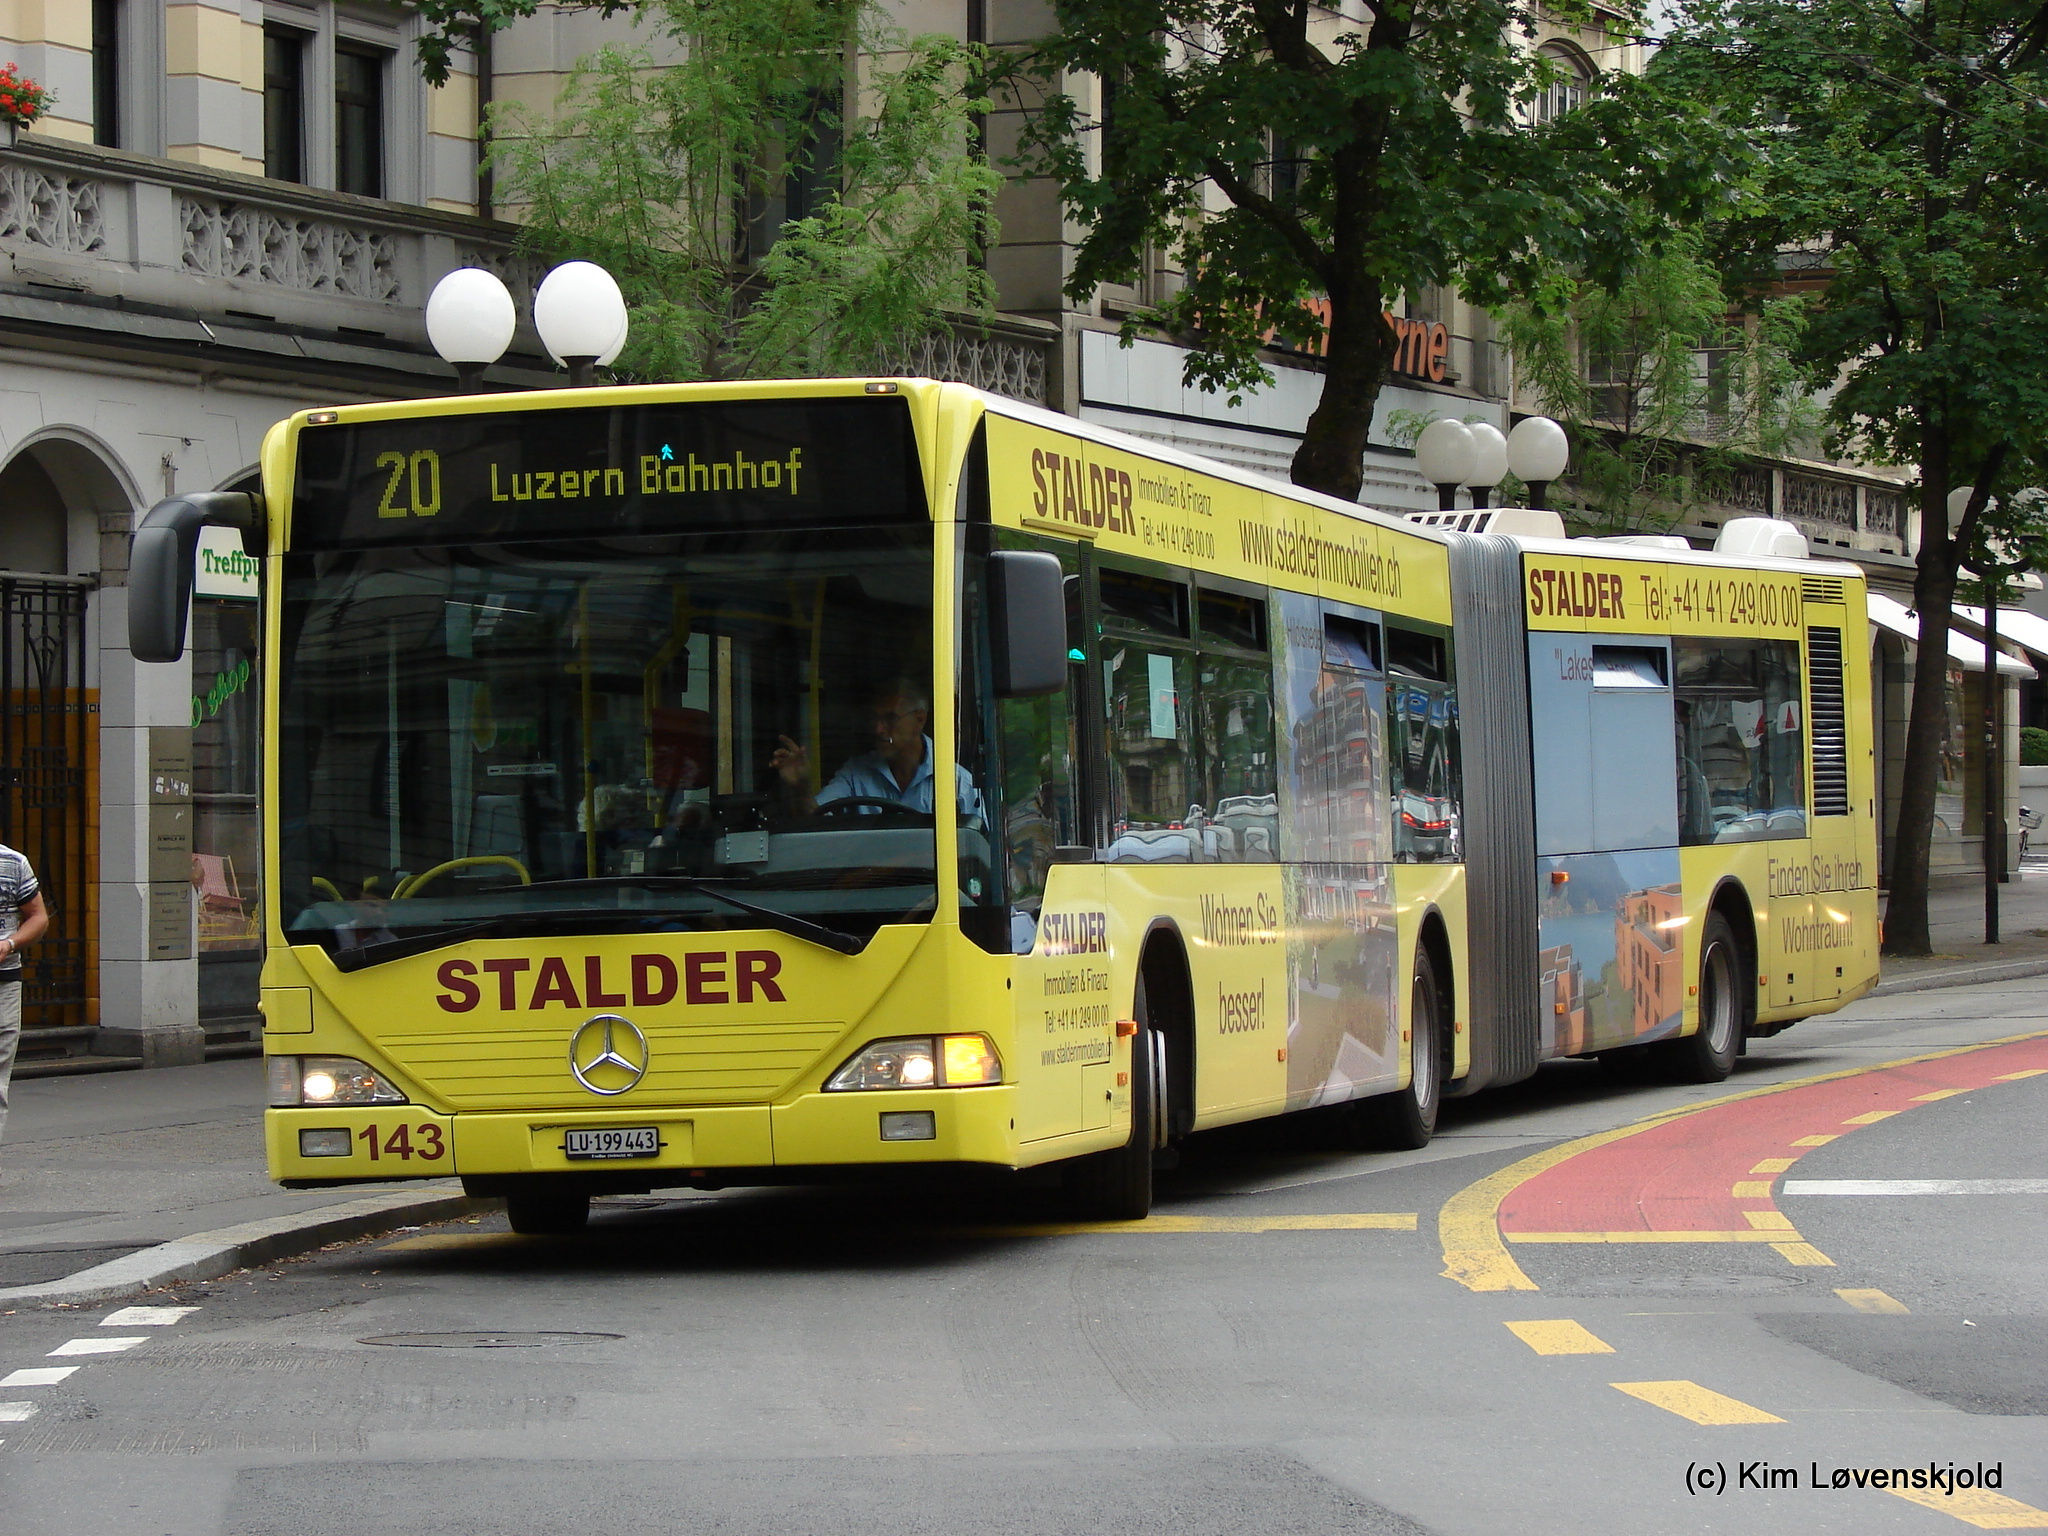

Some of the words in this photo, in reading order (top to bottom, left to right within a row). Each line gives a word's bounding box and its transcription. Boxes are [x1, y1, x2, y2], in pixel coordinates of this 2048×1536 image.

[376, 449, 441, 518] 20
[491, 463, 625, 502] Luzern
[640, 447, 802, 495] Bahnhof
[1031, 447, 1136, 537] STALDER
[1137, 470, 1180, 508] Immobilien
[1180, 481, 1187, 510] &
[1187, 483, 1213, 517] Finanz
[1156, 521, 1170, 549] +41
[1171, 524, 1180, 552] 41
[1181, 526, 1195, 555] 249
[1195, 530, 1205, 558] 00
[1206, 532, 1215, 560] 00
[1238, 518, 1402, 599] www.stalderimmobilien.ch
[1529, 568, 1626, 620] STALDER
[1673, 578, 1701, 623] +41
[1706, 579, 1723, 623] 41
[1728, 581, 1756, 625] 249
[1759, 583, 1778, 627] 00
[1782, 585, 1799, 628] 00
[207, 659, 250, 716] shop
[1769, 857, 1809, 895] Finden
[1812, 854, 1832, 892] Sie
[1834, 854, 1863, 890] ihren
[1043, 912, 1107, 957] STALDER
[1200, 893, 1255, 947] Wohnen
[1257, 892, 1277, 945] Sie
[1782, 910, 1853, 954] Wohntraum!
[436, 950, 787, 1013] STALDER
[1044, 969, 1080, 996] Immobilien
[1087, 968, 1108, 991] Finanz
[1219, 977, 1265, 1035] besser!
[1057, 1008, 1069, 1031] +41
[1070, 1008, 1078, 1030] 41
[1079, 1006, 1091, 1028] 249
[1092, 1005, 1101, 1027] 00
[1101, 1004, 1109, 1026] 00
[359, 1123, 445, 1161] 143
